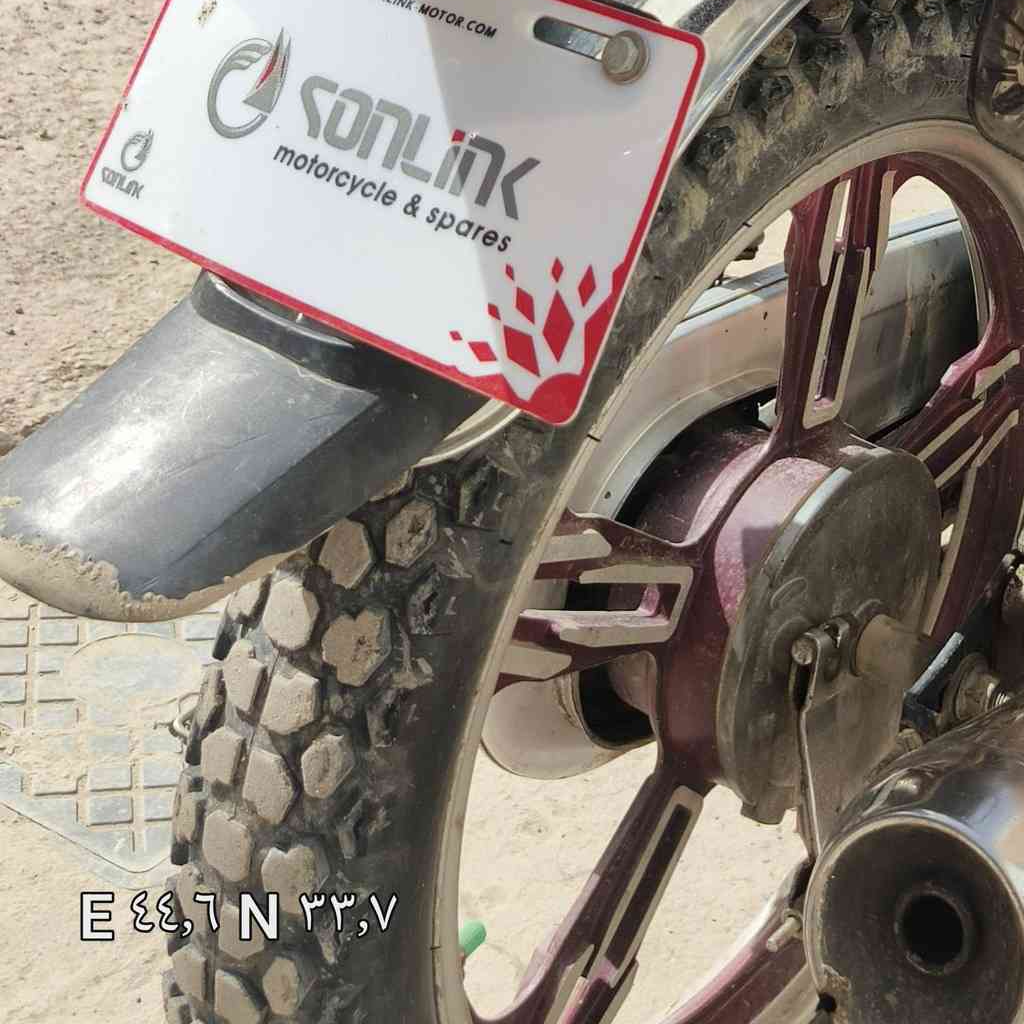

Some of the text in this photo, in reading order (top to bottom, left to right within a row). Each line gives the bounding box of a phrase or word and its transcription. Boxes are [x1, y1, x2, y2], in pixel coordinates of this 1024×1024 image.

[273, 142, 512, 253] motorcycle & spares
